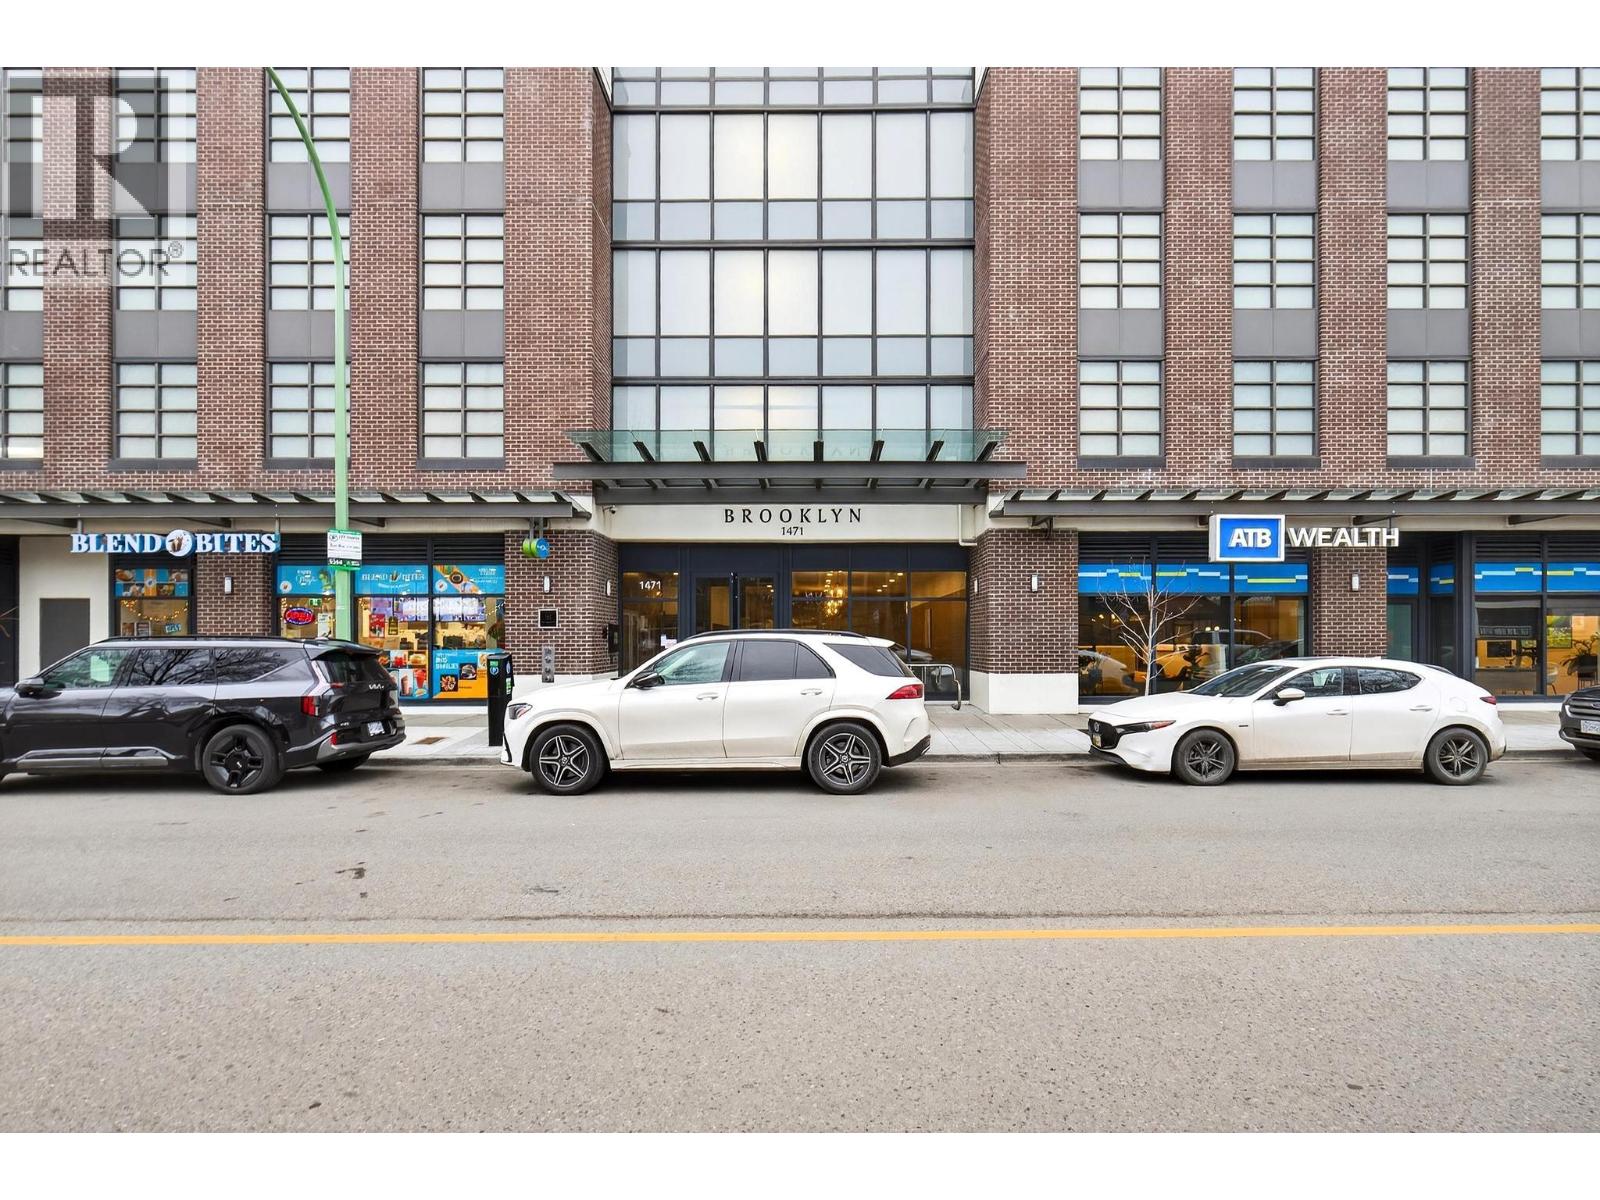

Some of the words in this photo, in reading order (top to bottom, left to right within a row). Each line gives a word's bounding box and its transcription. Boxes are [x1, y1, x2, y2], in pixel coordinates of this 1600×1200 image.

[724, 508, 861, 523] BROOKLYN
[781, 526, 804, 536] 1471
[1228, 528, 1272, 548] ATB
[1287, 527, 1400, 547] WEALTH
[70, 533, 162, 553] BLEND
[194, 533, 278, 553] BITES
[639, 580, 661, 590] 1471
